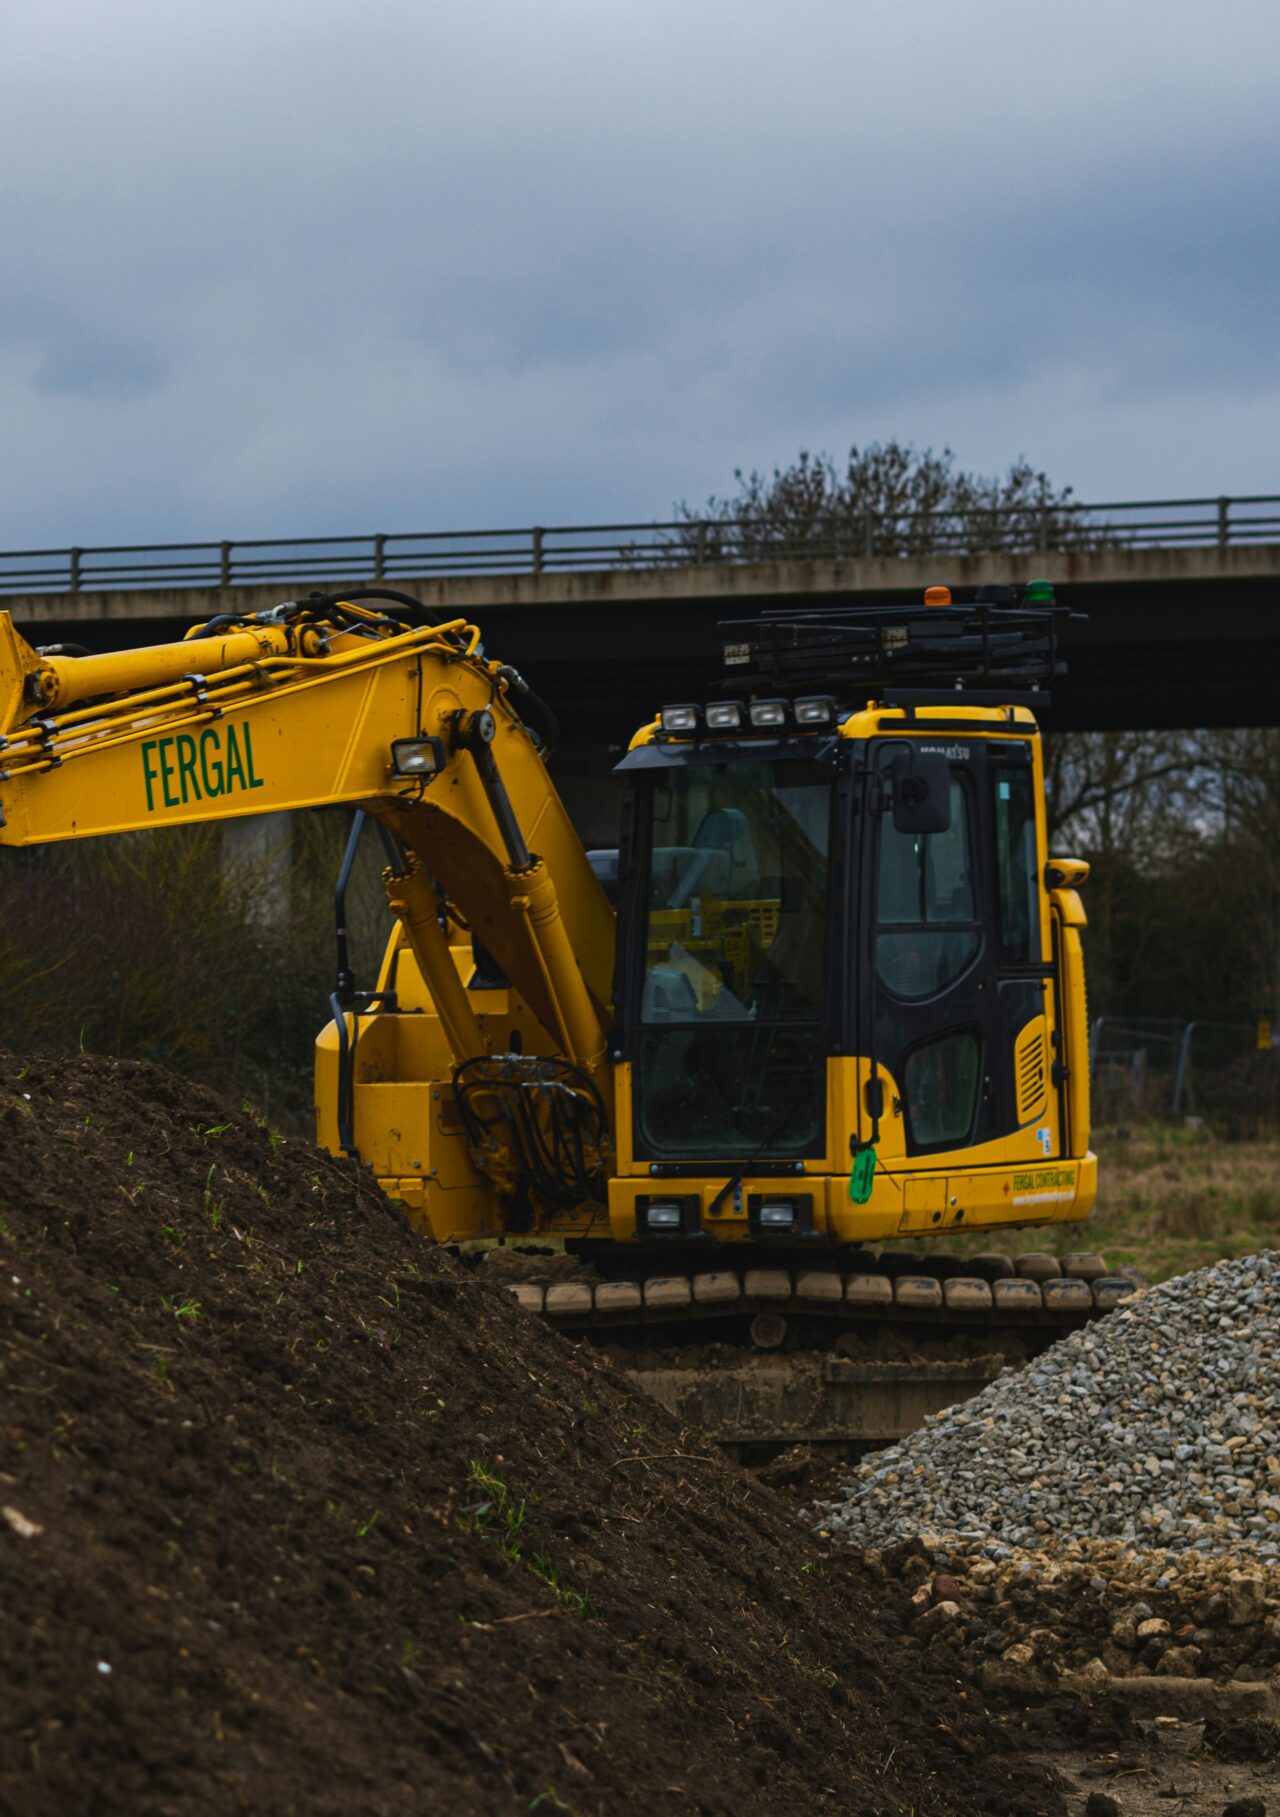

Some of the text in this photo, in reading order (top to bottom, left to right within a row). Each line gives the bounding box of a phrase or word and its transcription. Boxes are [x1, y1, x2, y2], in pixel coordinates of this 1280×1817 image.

[141, 721, 264, 811] FERGAL
[1013, 1169, 1075, 1191] FERGAL CONTRACTING
